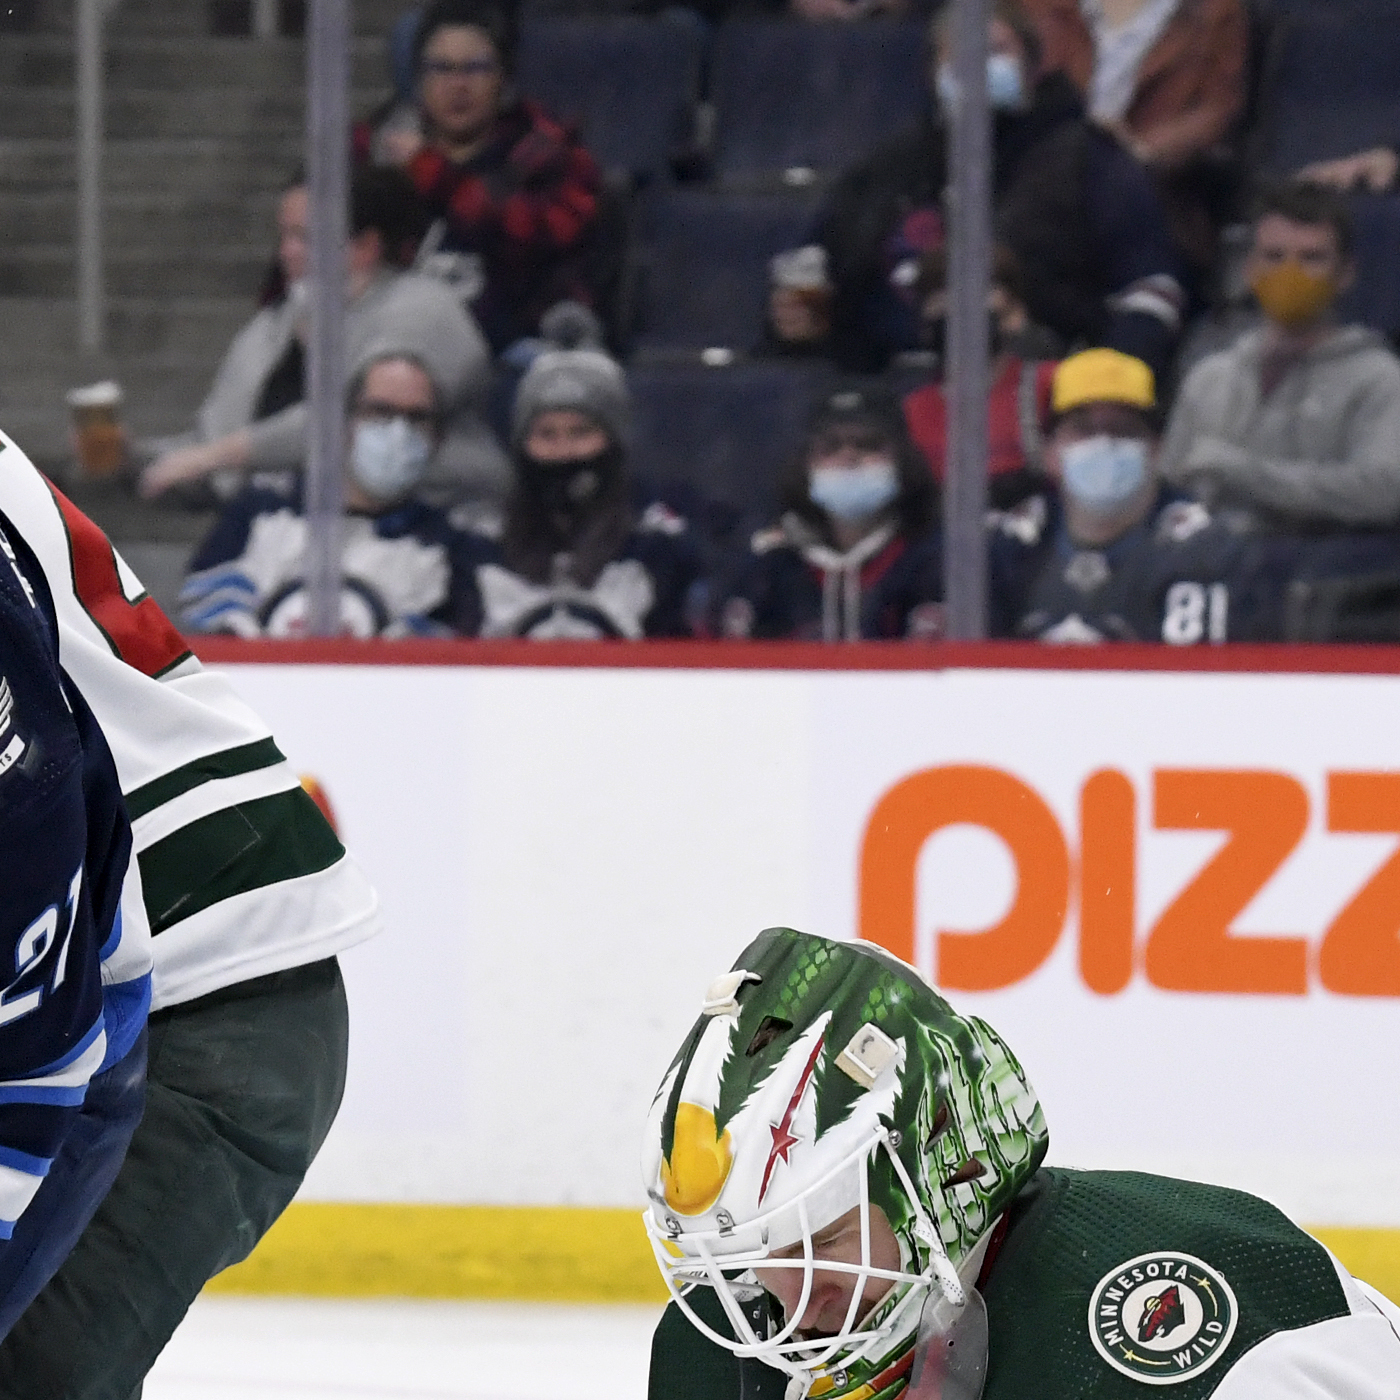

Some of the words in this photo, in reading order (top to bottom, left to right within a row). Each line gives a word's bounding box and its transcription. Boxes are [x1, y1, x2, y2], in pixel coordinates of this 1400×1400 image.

[1161, 580, 1230, 647] 81
[1099, 1261, 1189, 1347] MINNESOTA
[1172, 1320, 1223, 1369] WILD
